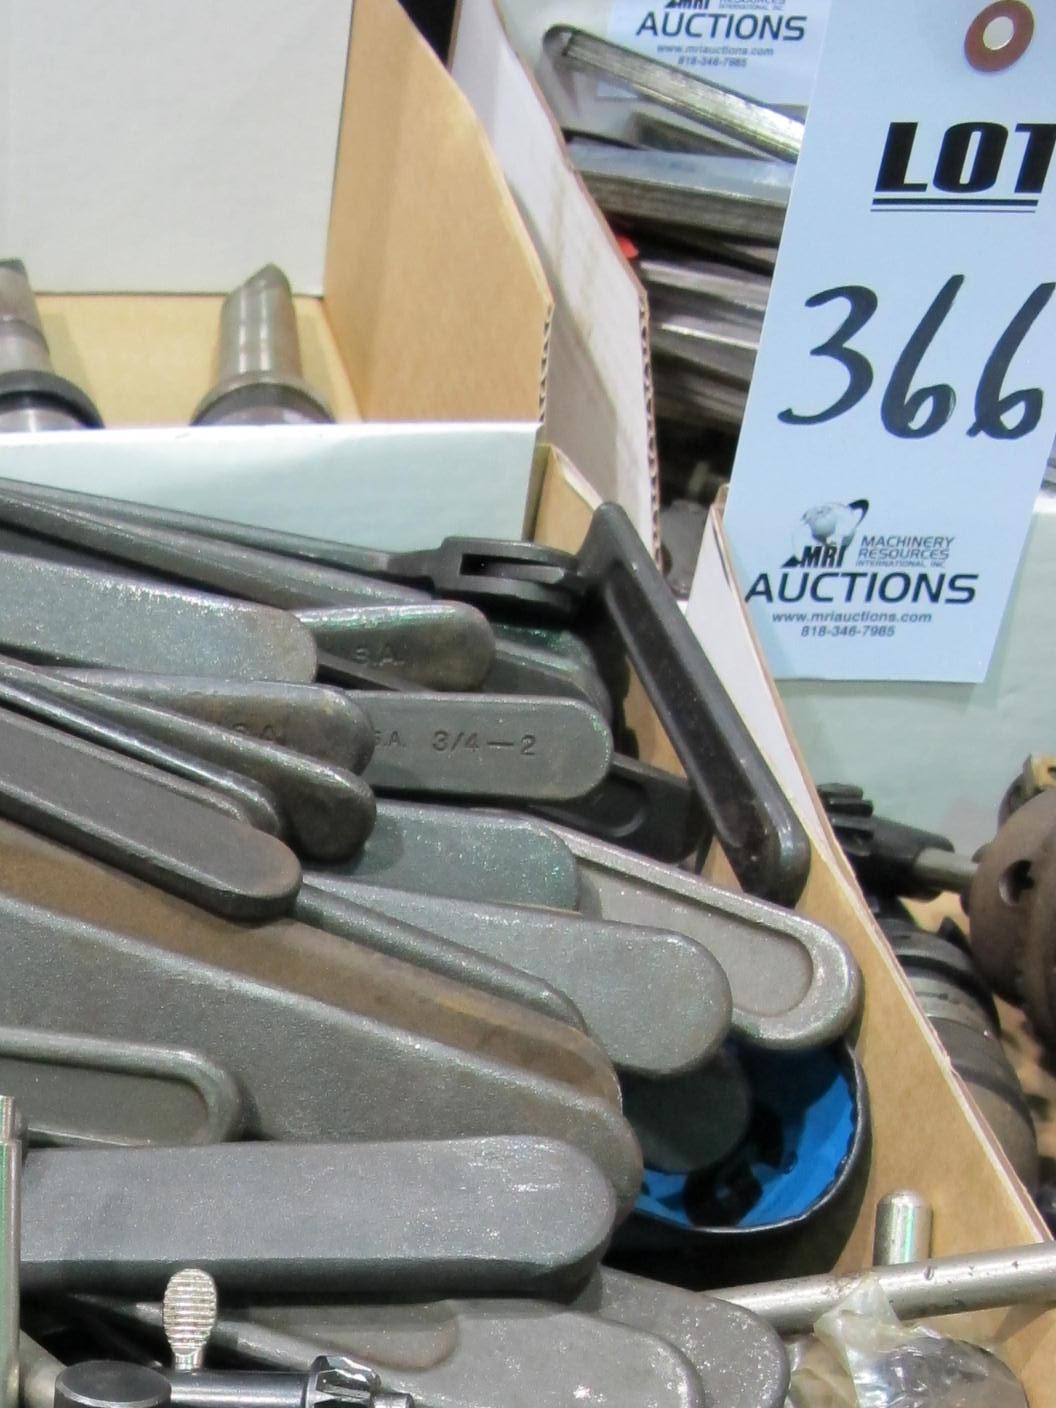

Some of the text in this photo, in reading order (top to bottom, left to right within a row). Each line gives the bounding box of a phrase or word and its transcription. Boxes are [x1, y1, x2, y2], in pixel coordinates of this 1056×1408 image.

[636, 11, 807, 41] AUCTIONS
[874, 122, 1056, 194] LOT
[777, 274, 1056, 440] 366
[860, 535, 955, 549] MACHINERY
[799, 545, 845, 568] MRI
[857, 547, 950, 561] RESOURCES
[745, 571, 980, 605] AUCTIONS
[771, 611, 933, 623] www.mriauctions.com
[800, 625, 896, 637] 818-346-7985
